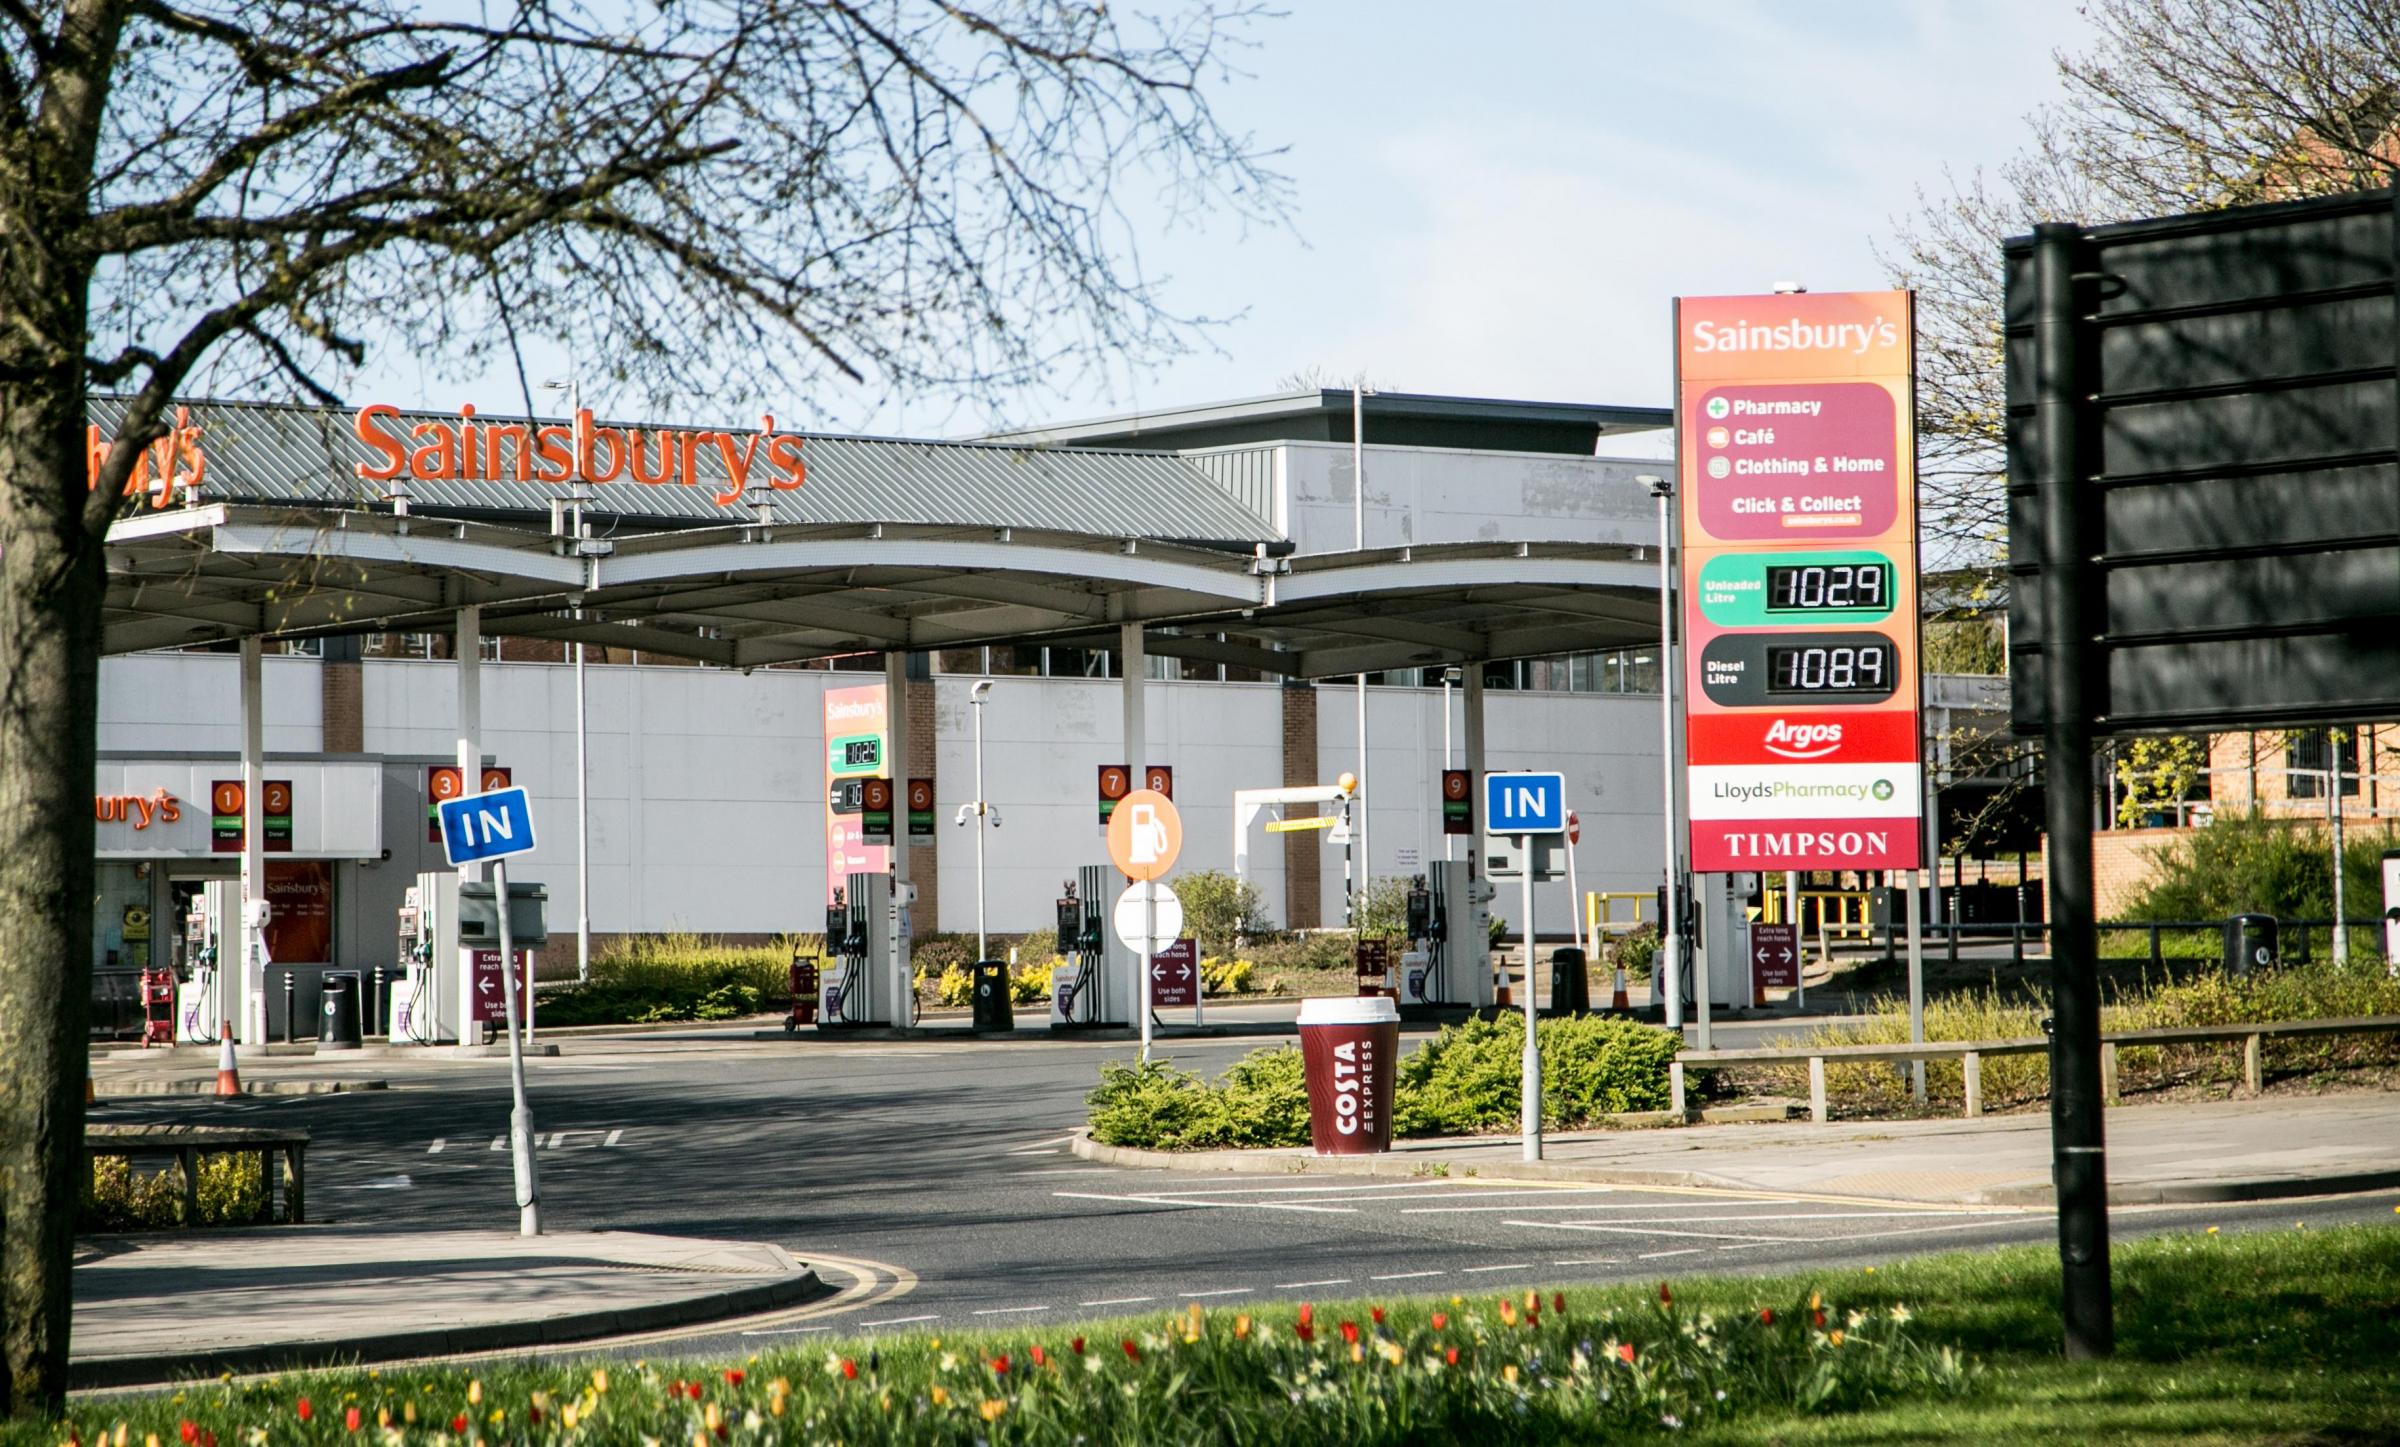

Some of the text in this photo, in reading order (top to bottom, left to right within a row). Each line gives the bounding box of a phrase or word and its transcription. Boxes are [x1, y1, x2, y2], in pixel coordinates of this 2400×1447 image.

[1693, 316, 1897, 354] Sainsbury's
[1733, 400, 1822, 416] Pharmacy
[1734, 428, 1775, 445] Café
[354, 403, 807, 507] Sainsbury's
[1735, 456, 1884, 476] Clothing & Home
[1732, 496, 1862, 513] Click & Collect
[1705, 580, 1761, 591] Unleaded
[1789, 567, 1881, 607] 102.9
[1705, 592, 1736, 603] Litre
[1707, 661, 1745, 672] Diesel
[1790, 648, 1883, 688] 108.9
[1707, 673, 1738, 684] Litre
[828, 700, 884, 719] Sainsbury's
[1765, 720, 1842, 748] Argos
[440, 777, 452, 794] 3
[488, 777, 500, 790] 4
[1108, 775, 1119, 791] 7
[1152, 776, 1163, 791] 8
[1452, 779, 1461, 792] 9
[1714, 781, 1868, 802] LloydsPharmacy
[224, 790, 231, 807] 1
[271, 790, 281, 806] 2
[871, 788, 882, 802] 5
[914, 789, 924, 803] 6
[1504, 787, 1545, 817] IN
[96, 787, 179, 830] ury's
[462, 805, 513, 847] IN
[1724, 832, 1888, 857] TIMPSON
[482, 954, 501, 962] Extra
[485, 1001, 498, 1009] Use
[491, 1010, 505, 1018] side
[1334, 1041, 1359, 1135] COSTA
[1362, 1041, 1373, 1120] EXPRESS
